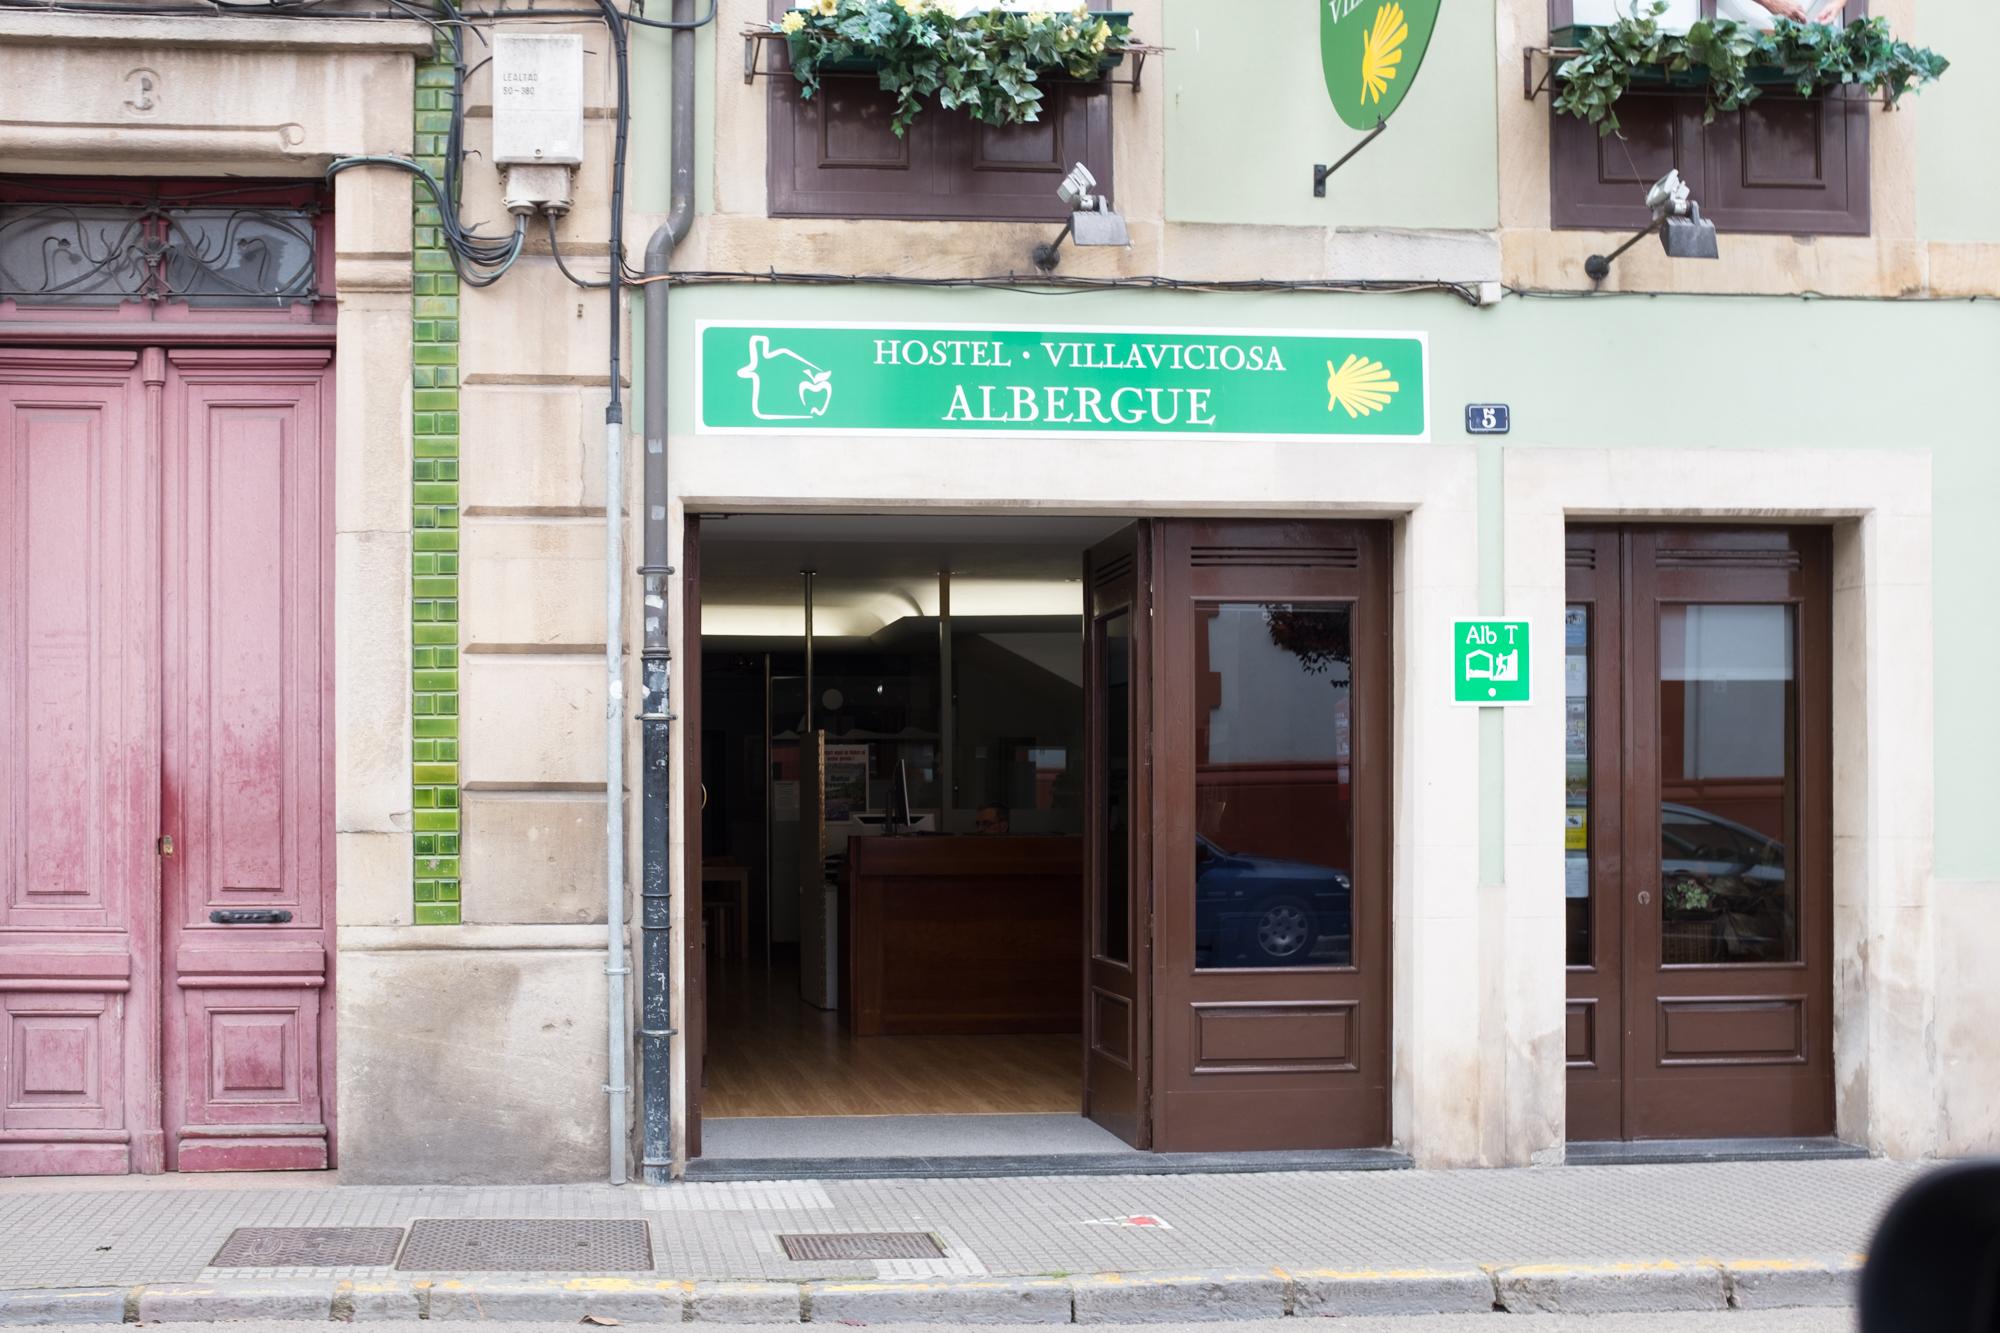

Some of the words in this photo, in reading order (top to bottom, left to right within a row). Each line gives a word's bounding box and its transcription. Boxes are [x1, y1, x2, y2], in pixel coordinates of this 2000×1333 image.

[503, 73, 538, 81] LEALTAD
[873, 339, 1012, 367] HOSTEL
[1040, 342, 1287, 371] VILLAVICIOSA
[941, 383, 1216, 425] ALBERGUE
[1482, 408, 1496, 428] 5
[1466, 625, 1497, 645] Alb
[1504, 624, 1519, 645] T
